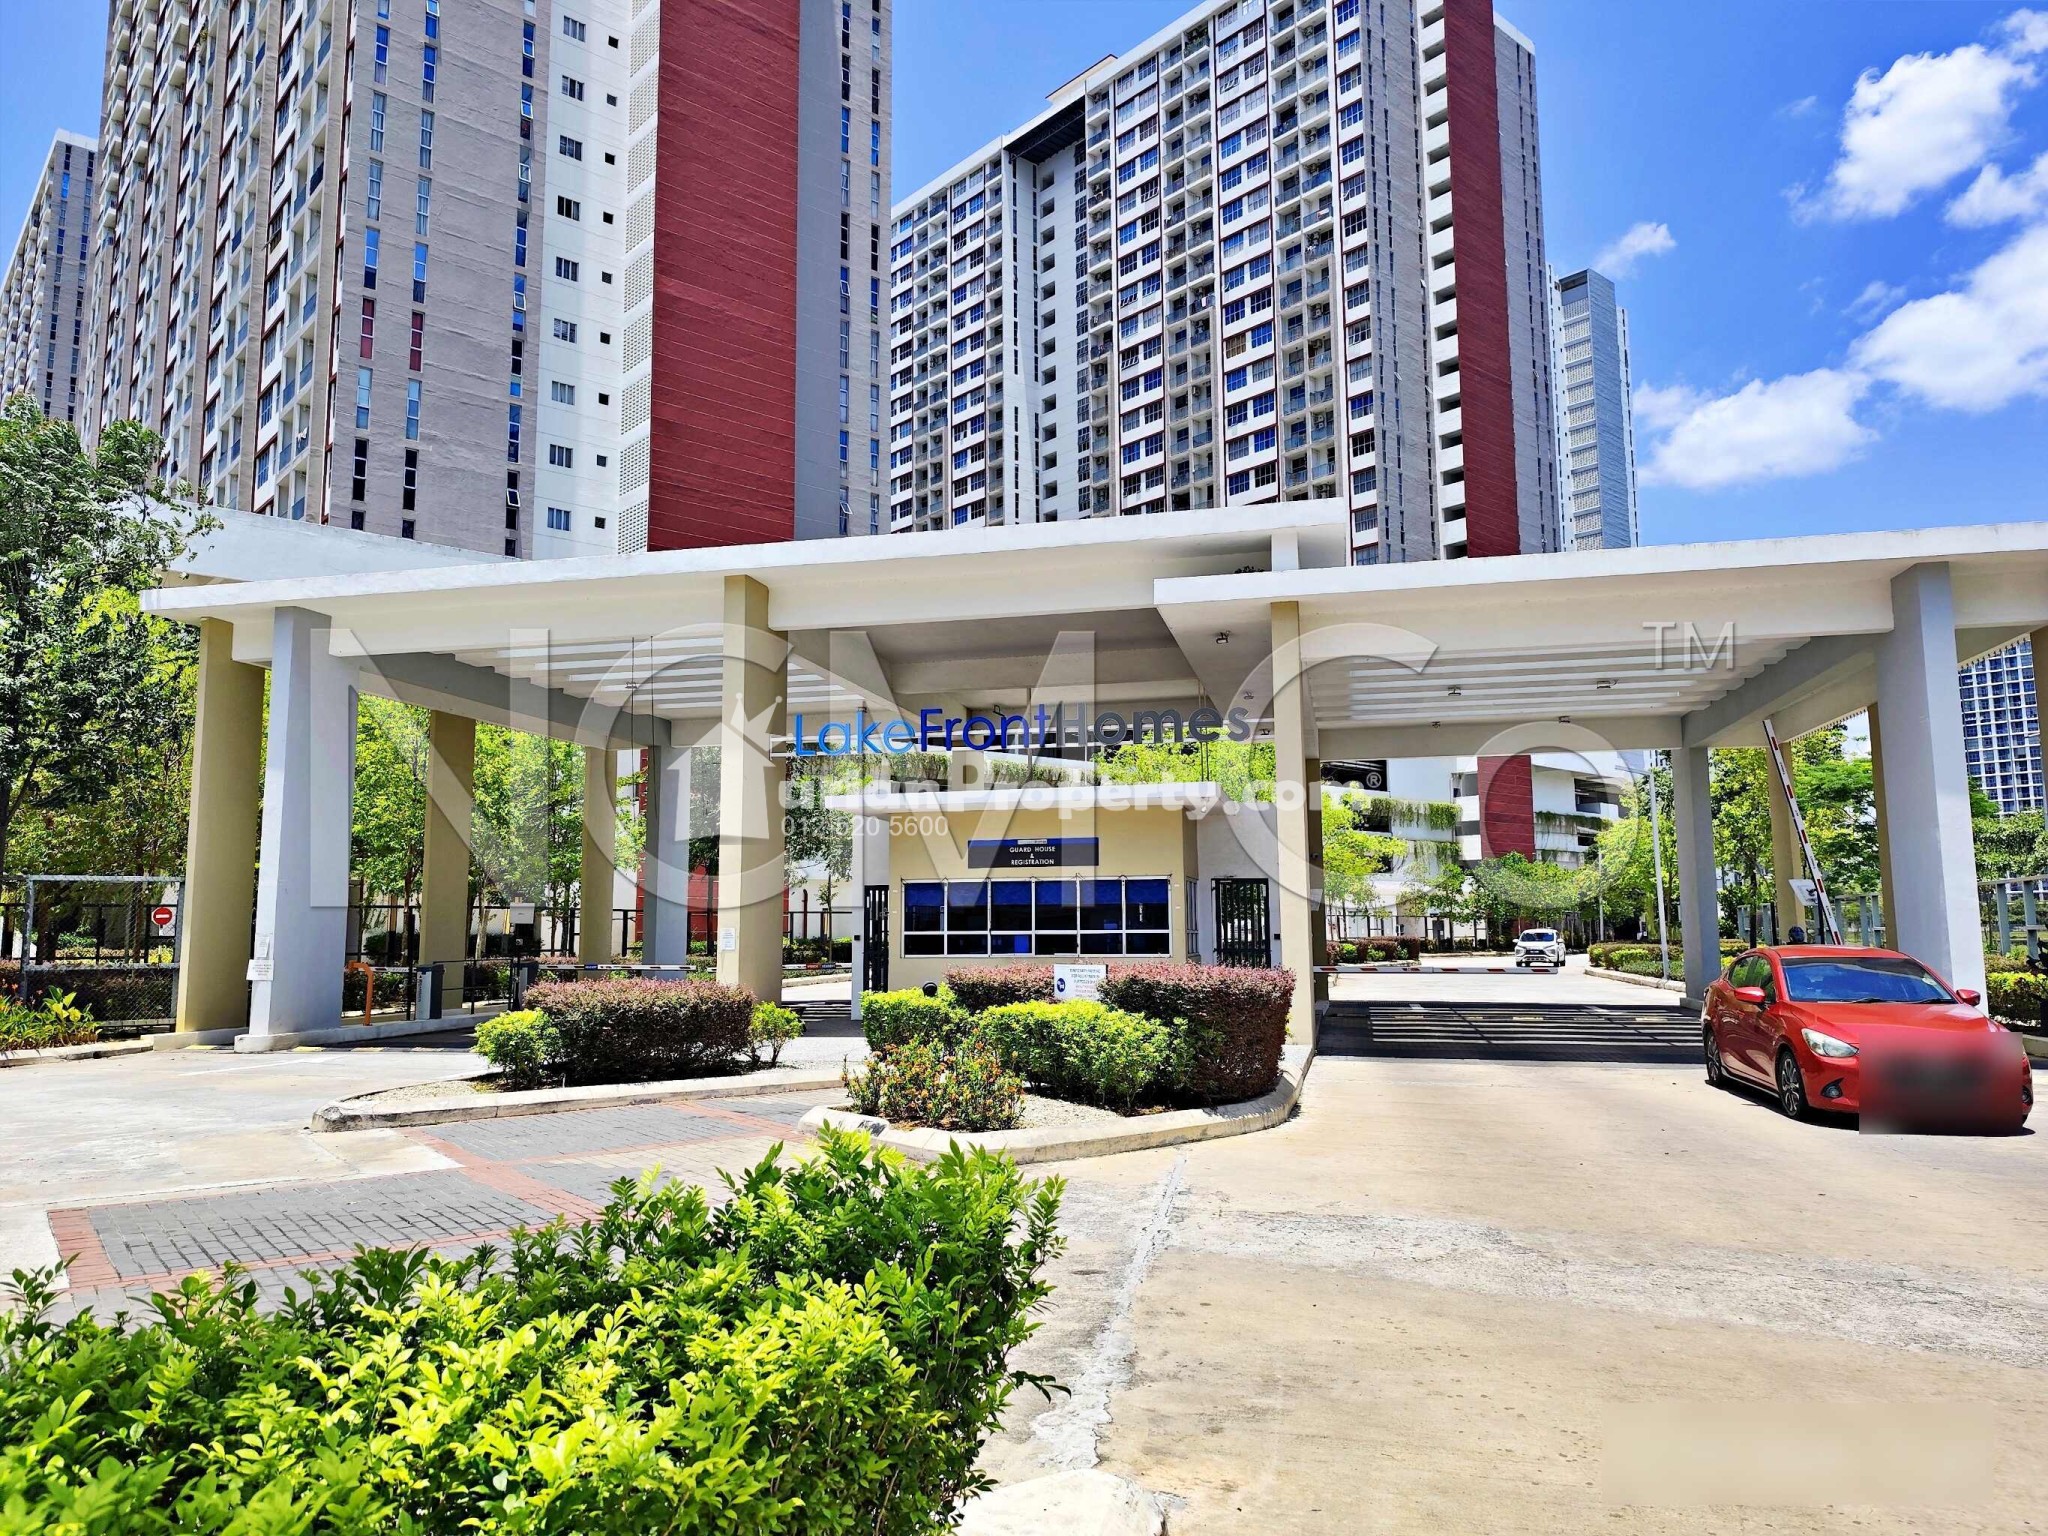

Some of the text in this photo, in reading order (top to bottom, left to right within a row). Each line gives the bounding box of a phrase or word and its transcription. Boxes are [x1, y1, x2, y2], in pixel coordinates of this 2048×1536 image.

[1009, 845, 1056, 854] GUARD HOUSE
[1010, 858, 1055, 866] REGISTRATION
